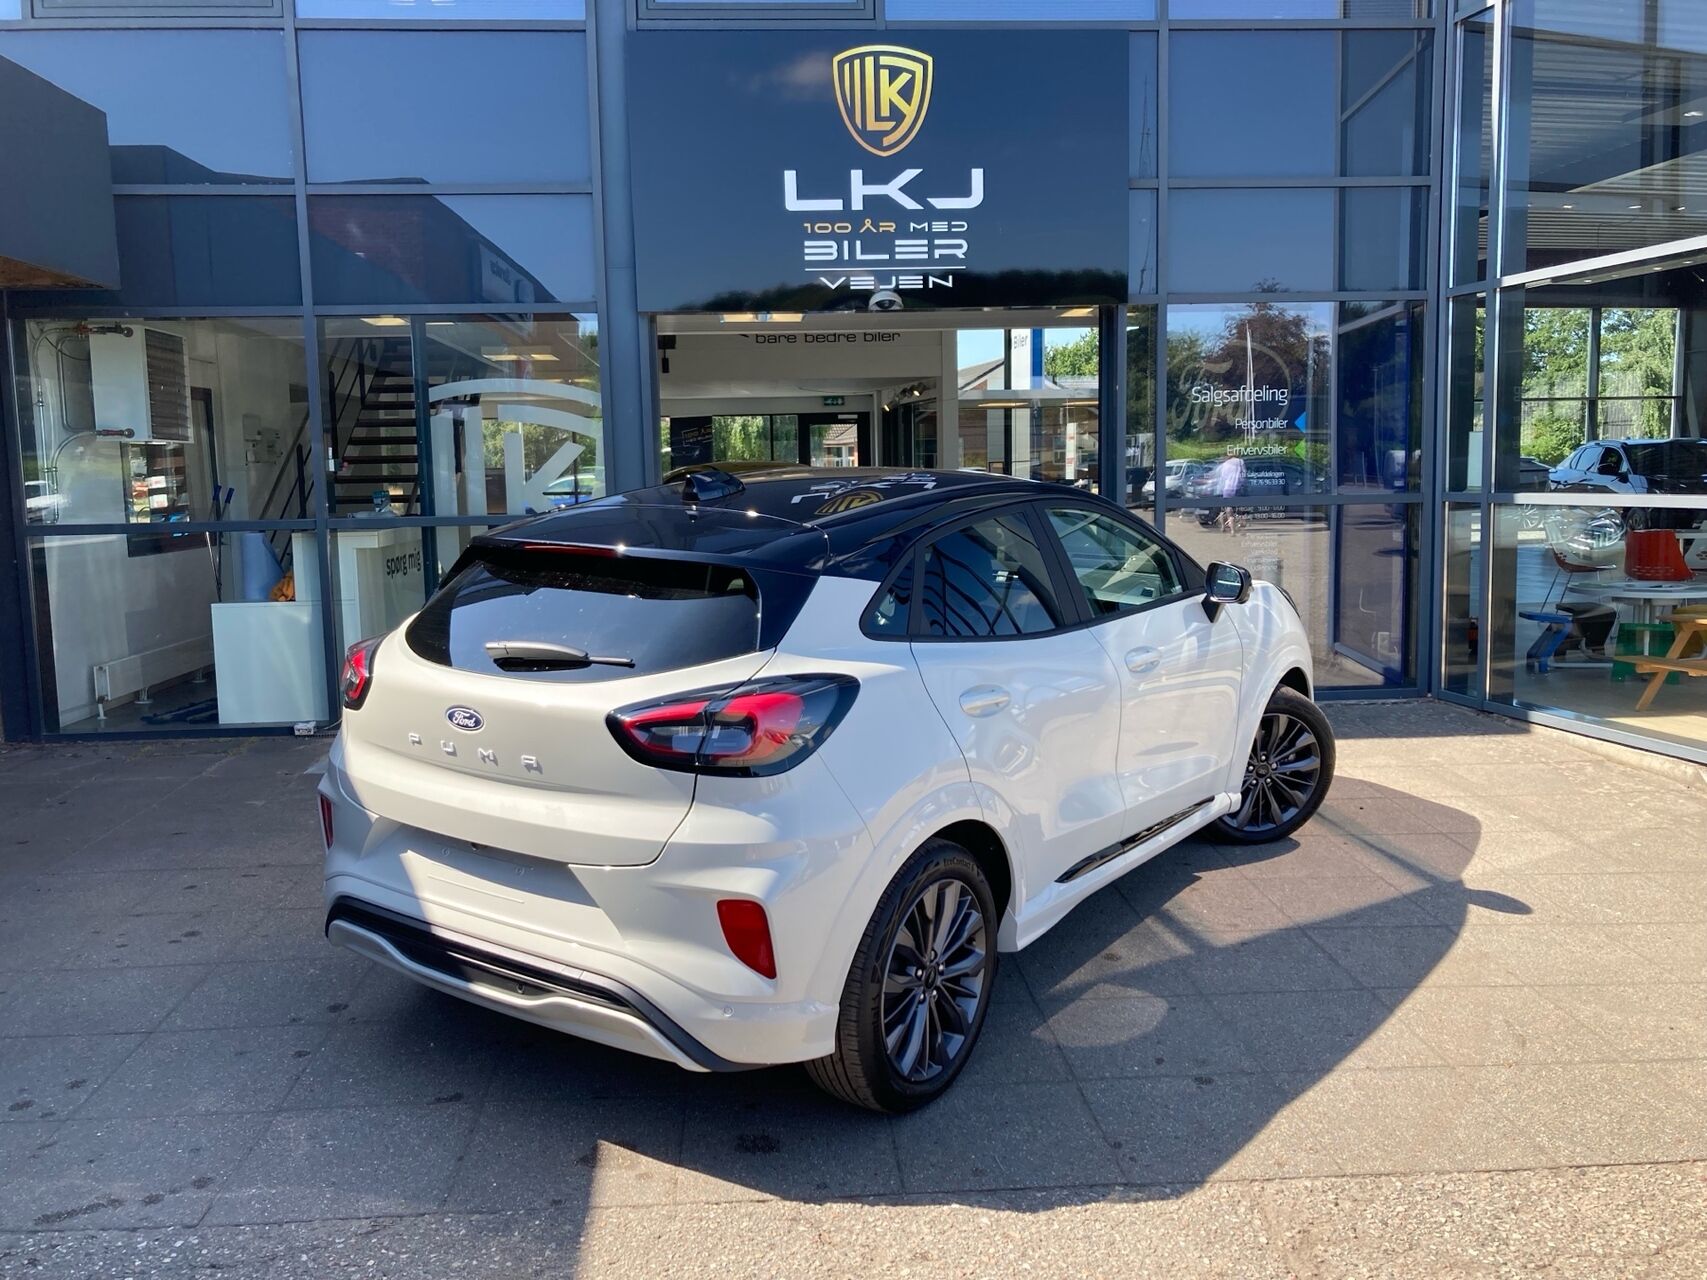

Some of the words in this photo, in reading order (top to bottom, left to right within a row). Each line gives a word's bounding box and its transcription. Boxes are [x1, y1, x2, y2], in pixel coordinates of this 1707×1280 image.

[784, 168, 984, 211] LKJ
[803, 222, 852, 234] 100
[859, 218, 896, 233] ÅR
[910, 221, 968, 232] MED
[804, 239, 968, 261] BILER
[819, 275, 953, 290] VEJEN
[755, 333, 797, 344] bare
[804, 332, 857, 344] bedre
[863, 332, 900, 343] biler
[1191, 385, 1289, 407] Salgsafdeling
[1235, 417, 1289, 430] Personbiler
[1226, 444, 1289, 457] Erhvervsbiler
[408, 547, 421, 573] mig
[452, 710, 476, 728] Ford
[408, 732, 538, 769] PUMA
